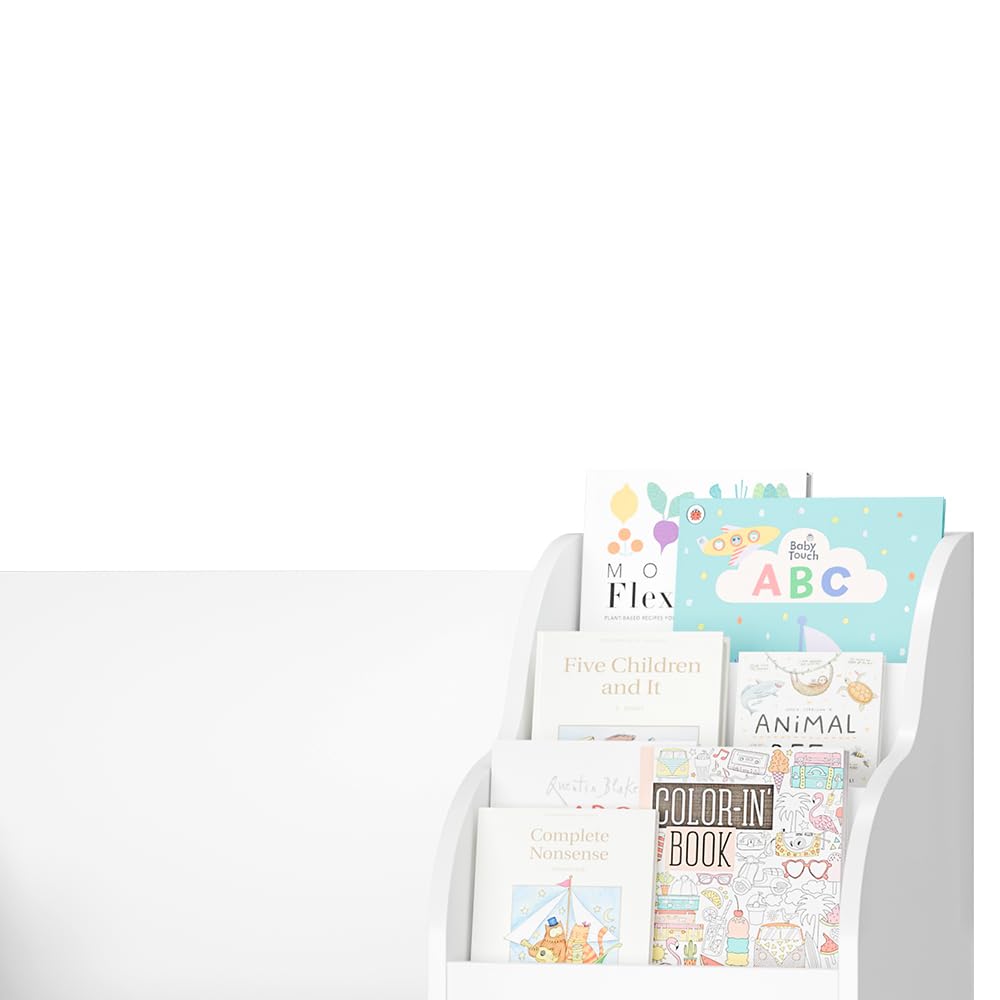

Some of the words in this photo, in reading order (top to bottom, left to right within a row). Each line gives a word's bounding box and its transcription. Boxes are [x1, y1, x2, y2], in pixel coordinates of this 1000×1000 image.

[790, 540, 817, 553] Baby
[788, 550, 819, 561] Touch
[752, 563, 851, 599] ABC
[564, 656, 606, 673] Five
[611, 655, 701, 673] Children
[601, 679, 643, 696] and
[647, 680, 661, 696] It
[530, 827, 609, 846] Complete
[529, 845, 609, 862] Nonsense
[668, 830, 733, 868] BOOK
